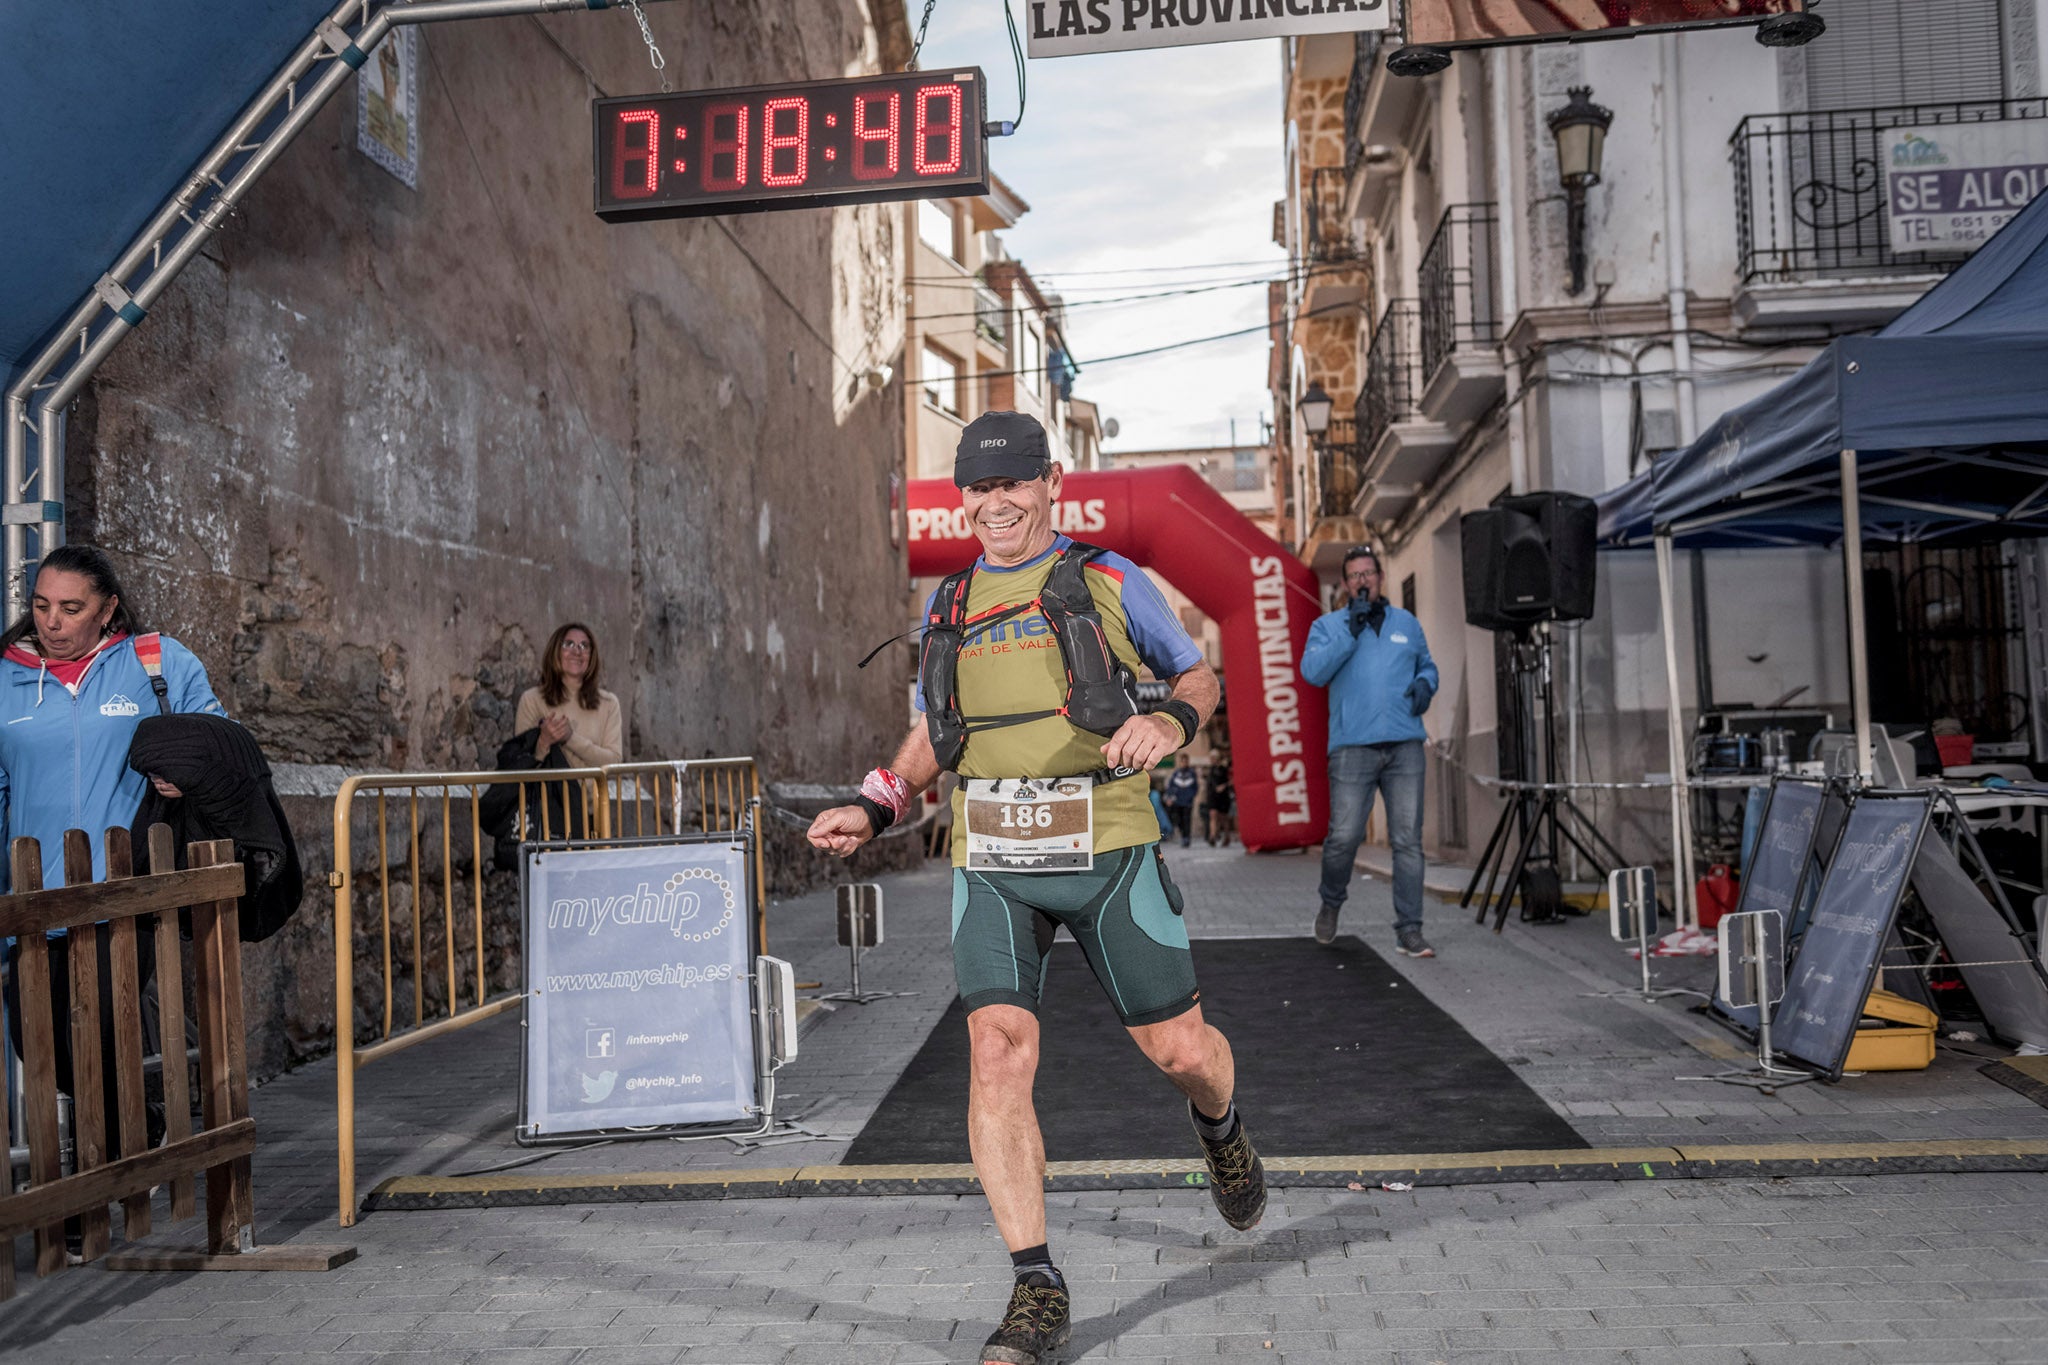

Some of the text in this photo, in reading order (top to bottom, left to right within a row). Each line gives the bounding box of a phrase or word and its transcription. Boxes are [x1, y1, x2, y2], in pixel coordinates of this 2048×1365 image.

[1033, 0, 1383, 39] LAS PROVIN
[616, 84, 963, 193] 7:18:40
[1897, 174, 1942, 211] SE
[991, 643, 1013, 655] DE
[1250, 556, 1311, 826] LAS PROVINCIAS
[1000, 804, 1053, 828] 186
[549, 883, 700, 936] mychip
[547, 963, 732, 992] www.mychip.es
[626, 1032, 689, 1046] /infomychip
[625, 1073, 702, 1090] @Mychip_Info
